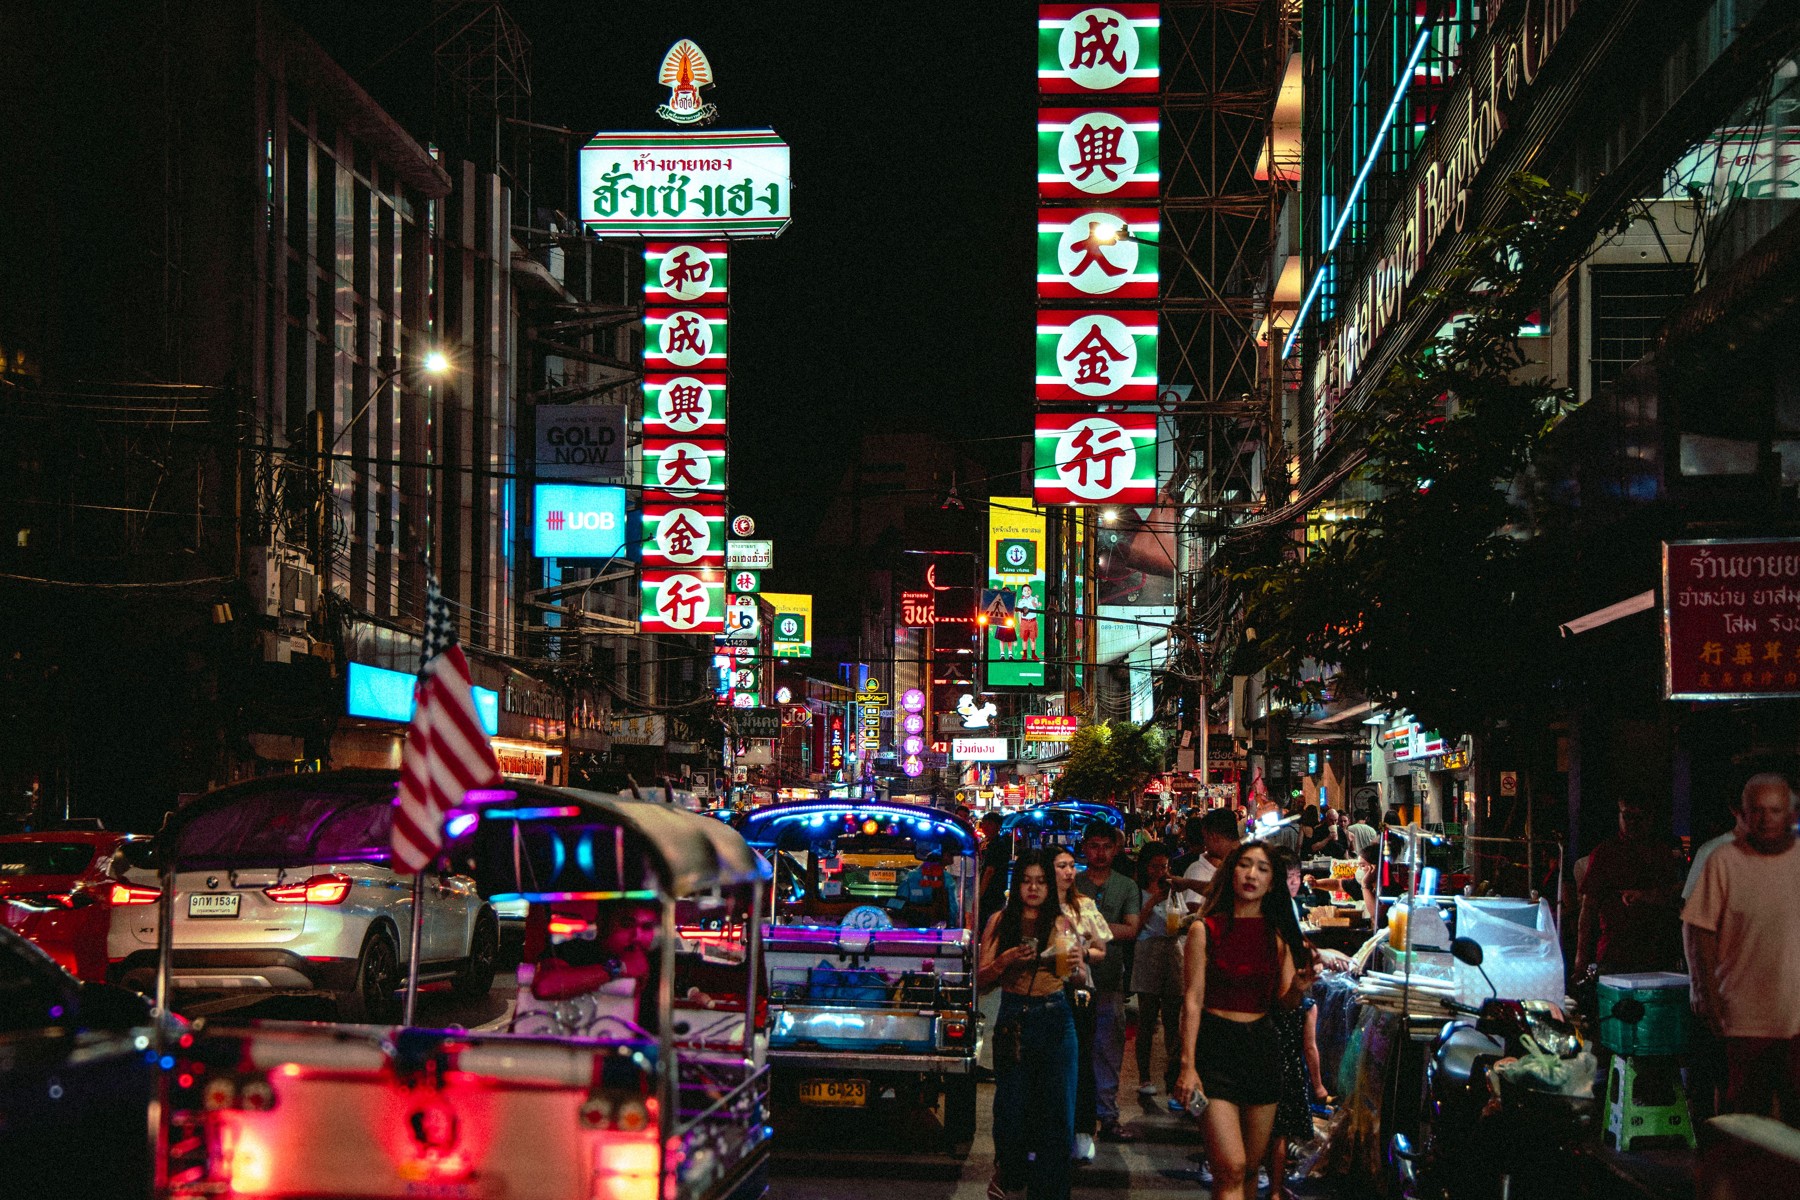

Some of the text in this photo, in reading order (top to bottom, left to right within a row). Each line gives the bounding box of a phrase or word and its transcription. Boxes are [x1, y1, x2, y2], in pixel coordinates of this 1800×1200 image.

[633, 153, 733, 172] ห้างขายทอง
[593, 162, 780, 218] ฮั่วเซ่งเฮง
[1338, 274, 1376, 391] Hotel
[1377, 184, 1425, 328] Royal
[1427, 43, 1504, 252] Bangkok
[547, 426, 616, 447] GOLD
[660, 251, 711, 625] 和成興大金行
[555, 447, 608, 465] NOW
[568, 512, 615, 530] UOB
[1690, 549, 1800, 579] ร้านขายย
[1678, 586, 1745, 607] จำหน่าย
[1723, 613, 1757, 634] โสม
[731, 639, 748, 647] 1428
[215, 896, 237, 906] 1534
